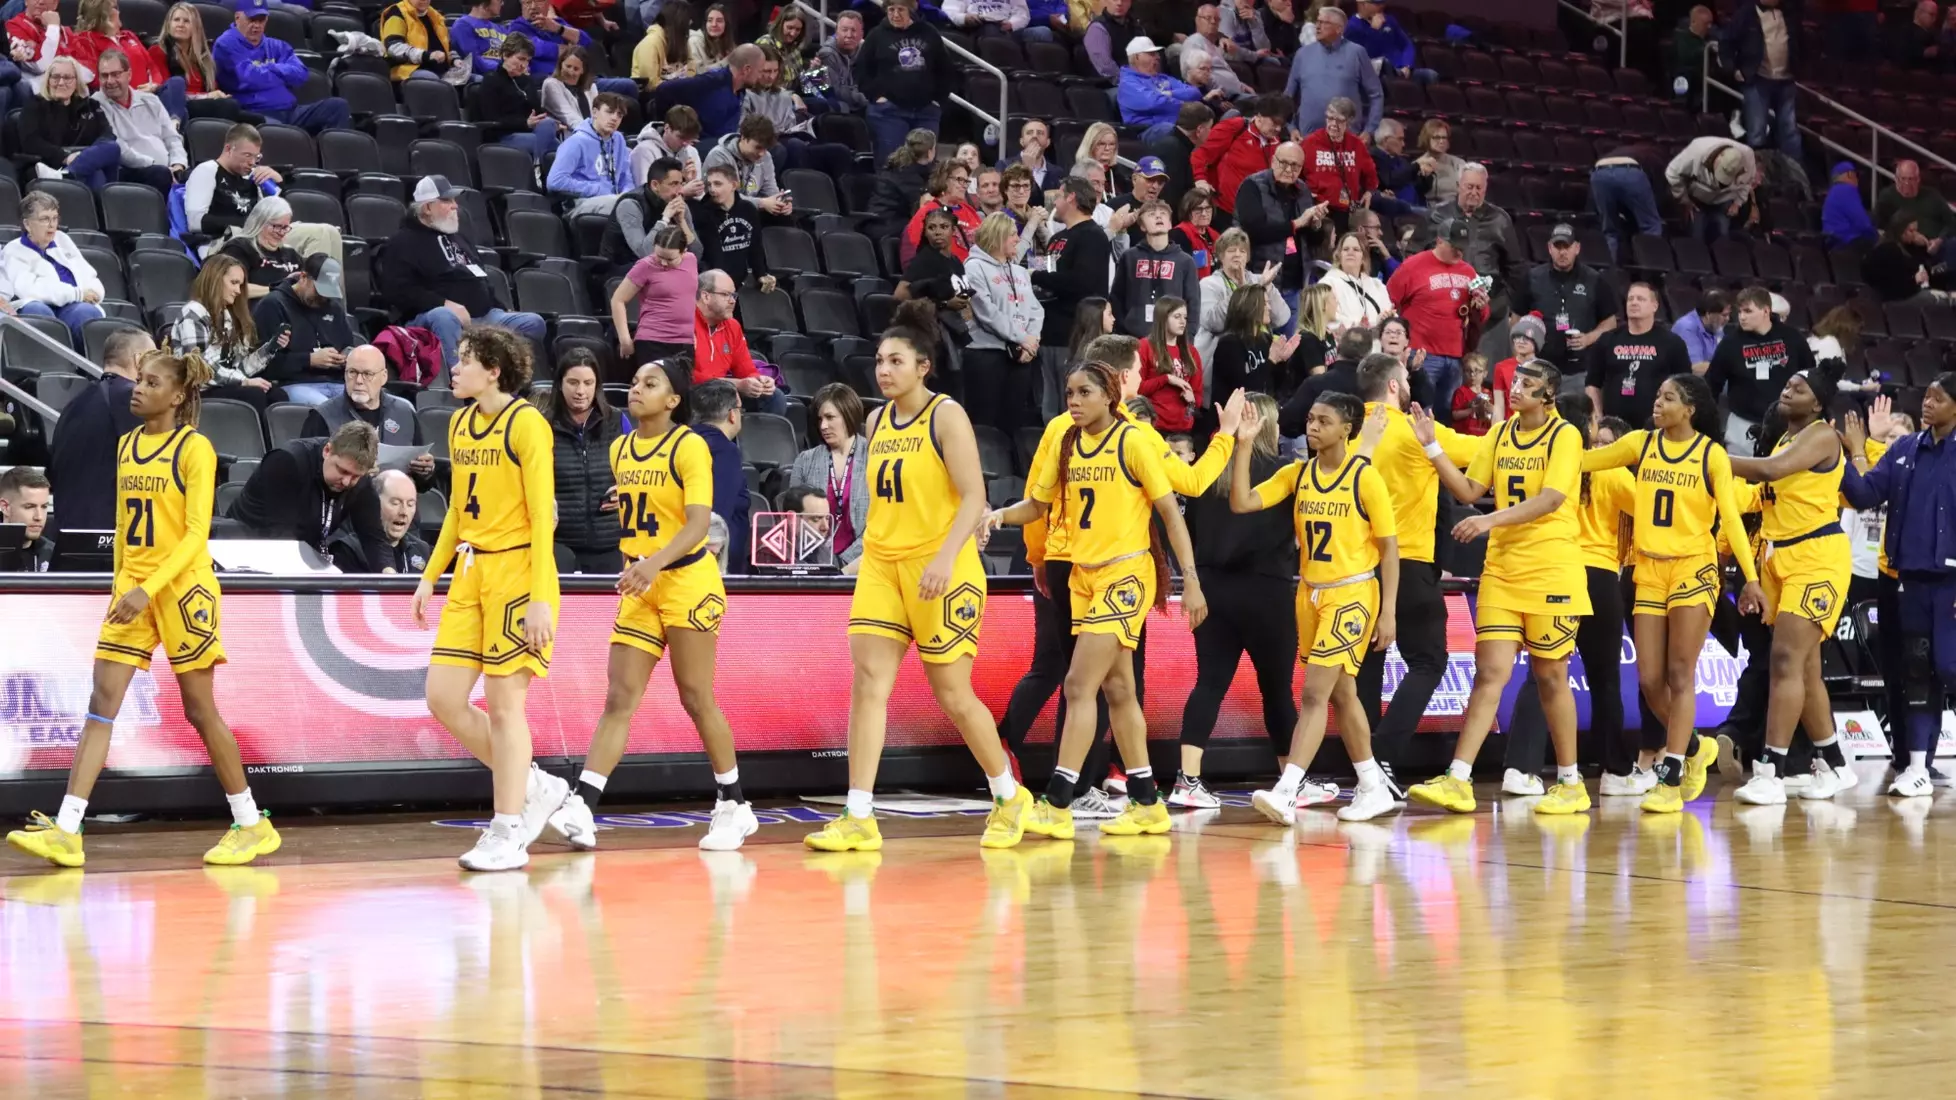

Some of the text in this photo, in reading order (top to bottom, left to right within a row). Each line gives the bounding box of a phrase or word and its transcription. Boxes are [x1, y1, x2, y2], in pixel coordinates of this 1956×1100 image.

[481, 448, 501, 466] CITY
[901, 436, 924, 452] CITY
[145, 475, 169, 493] CITY
[642, 469, 667, 487] CITY
[876, 458, 904, 503] 41
[1065, 466, 1116, 482] ANSAS CITY
[1641, 467, 1700, 489] KANSAS CITY
[464, 472, 480, 520] 4
[1507, 475, 1527, 508] 5
[618, 492, 660, 538] 24
[1079, 487, 1095, 530] 2
[1327, 501, 1351, 518] CITY
[1652, 488, 1675, 528] 0
[126, 497, 155, 547] 21
[1305, 520, 1332, 562] 12
[247, 766, 304, 774] DAKTRONICS
